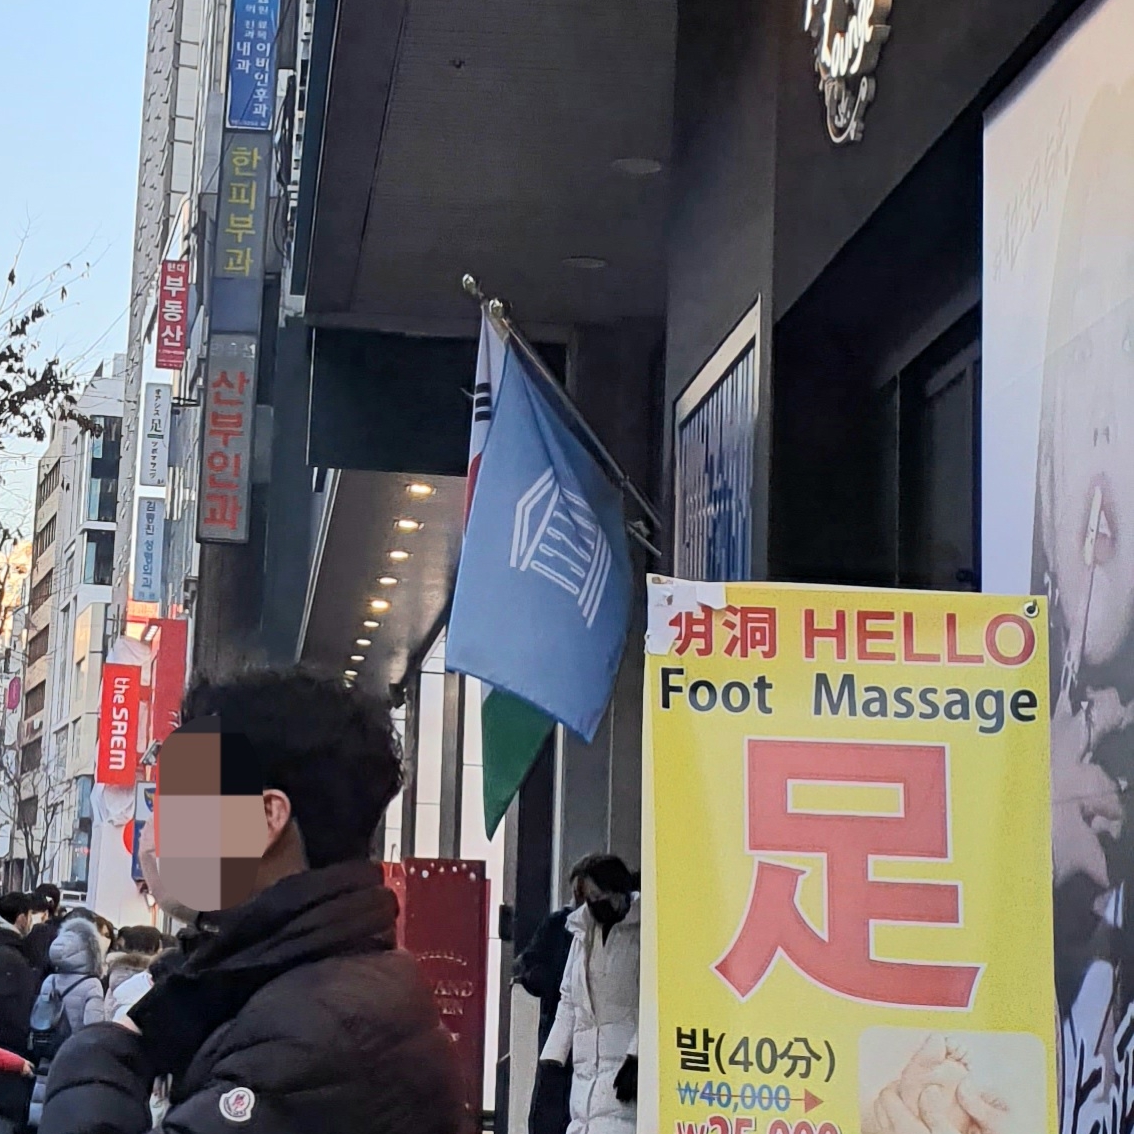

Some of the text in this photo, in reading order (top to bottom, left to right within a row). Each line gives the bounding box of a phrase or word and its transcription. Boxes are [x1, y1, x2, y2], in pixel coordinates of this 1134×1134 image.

[236, 42, 251, 74] 내과
[253, 42, 271, 118] 이비인후과
[223, 146, 262, 277] 한피부과
[161, 275, 186, 347] 부동산
[203, 370, 251, 530] 산부인과
[803, 607, 1036, 666] HELLO
[109, 677, 130, 770] the SAEM
[661, 667, 1037, 733] Foot Massage
[712, 737, 985, 1011] 足
[676, 1026, 836, 1083] 발(40分)
